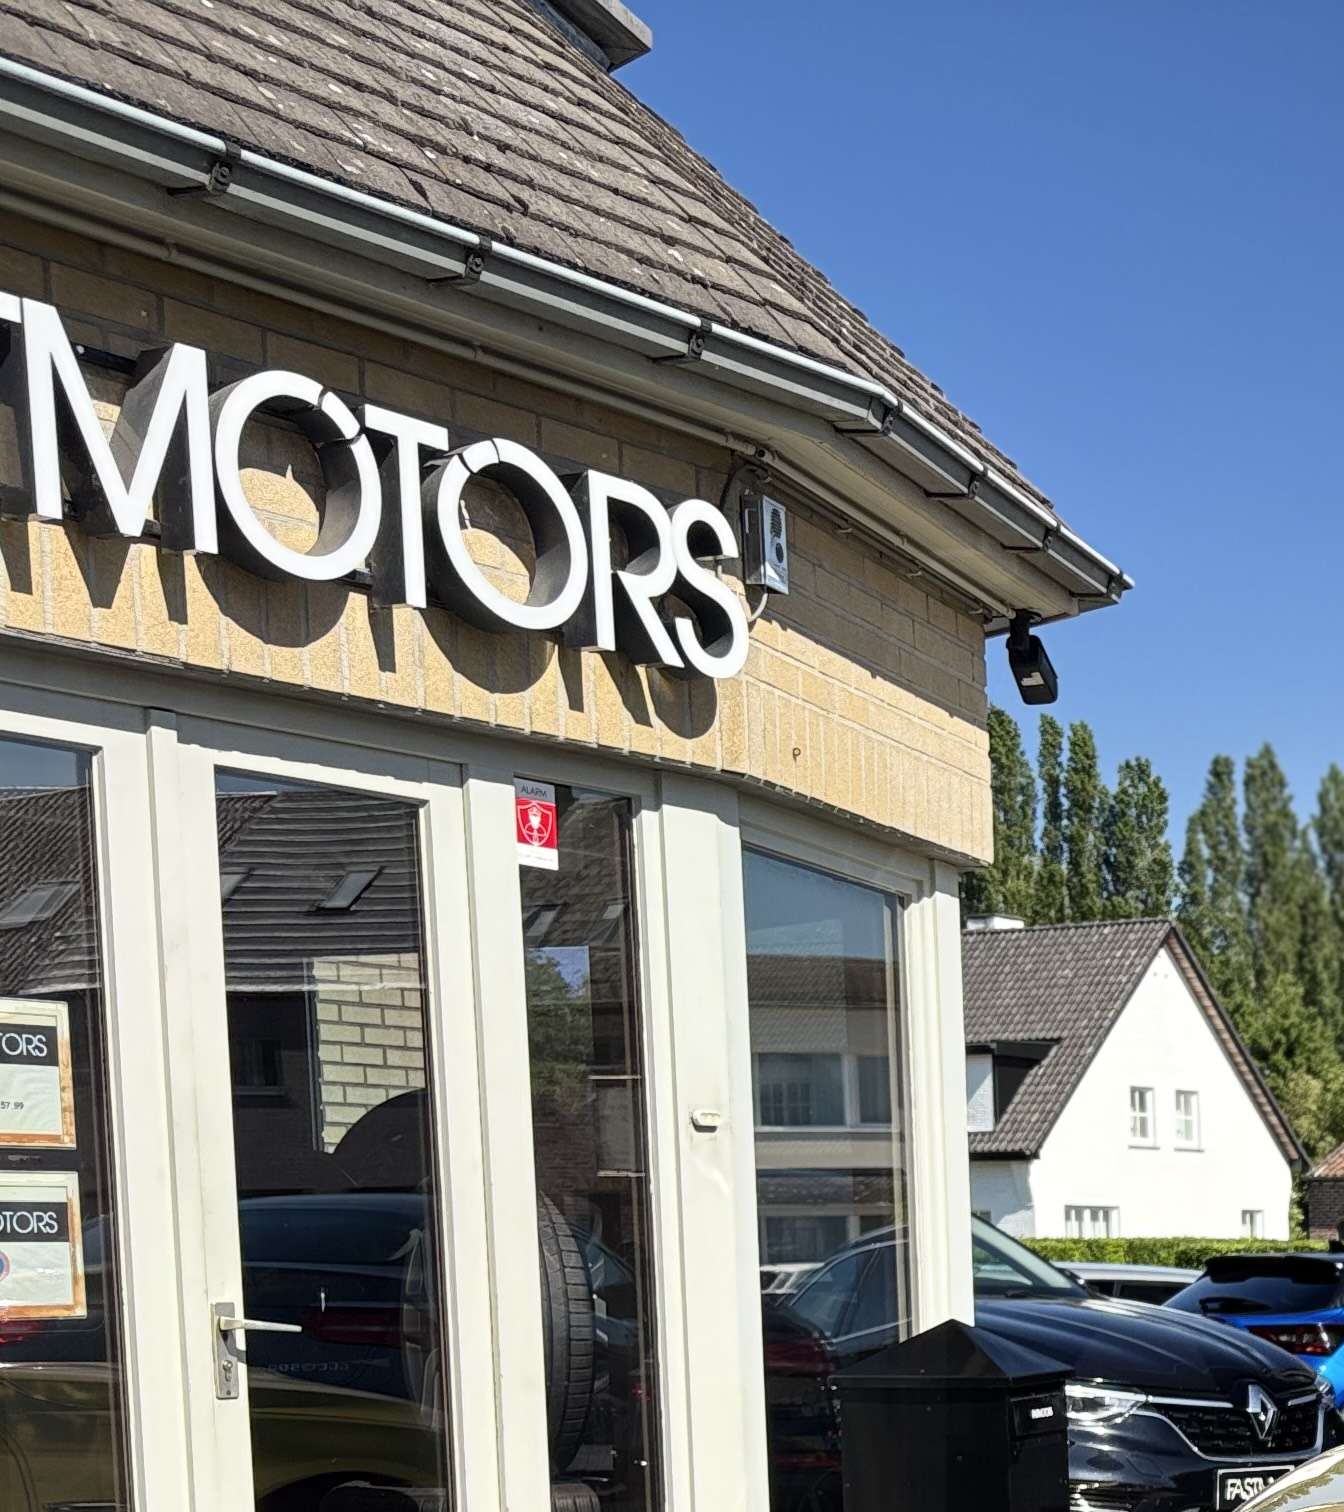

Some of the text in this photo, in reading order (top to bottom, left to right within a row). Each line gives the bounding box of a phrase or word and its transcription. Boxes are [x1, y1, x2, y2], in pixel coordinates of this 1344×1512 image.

[0, 292, 750, 679] MOTORS
[0, 1032, 47, 1057] ORS
[0, 1211, 58, 1234] TORS
